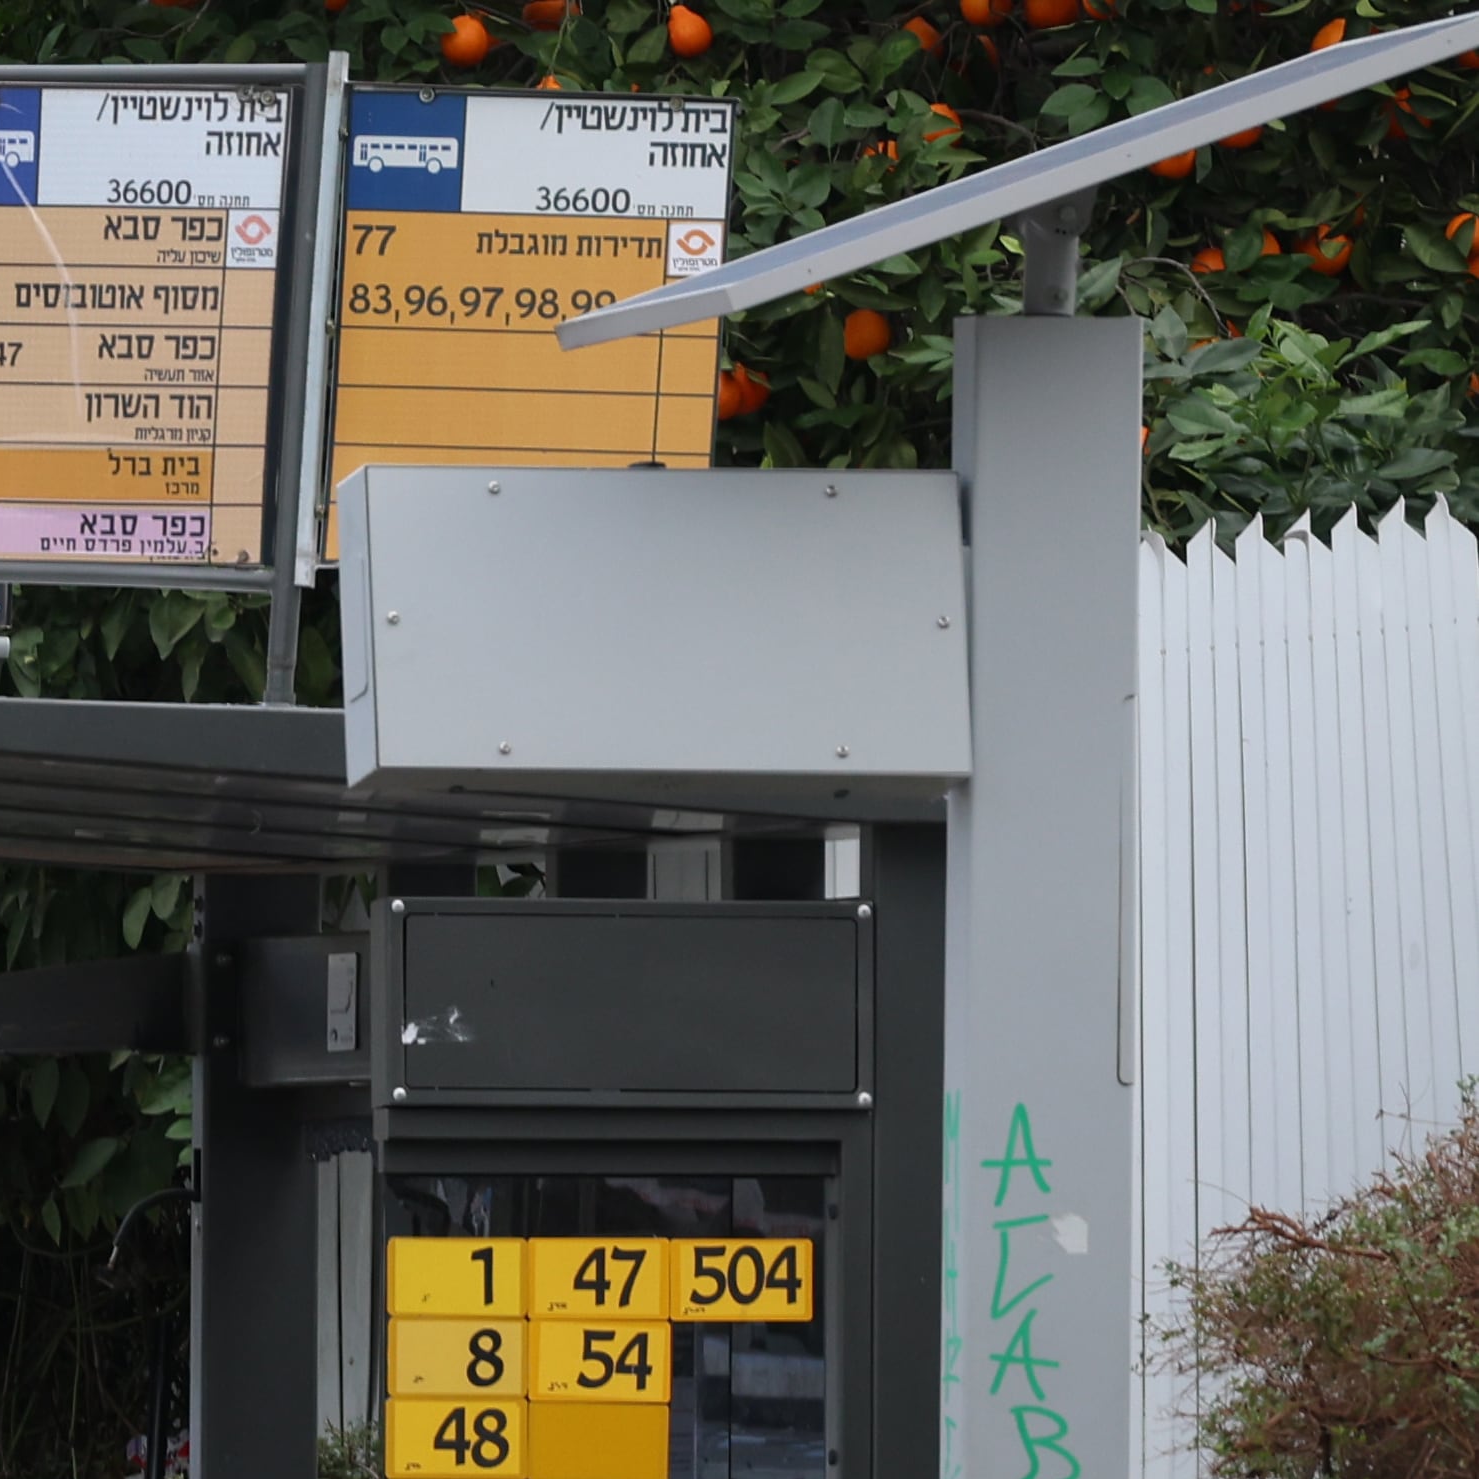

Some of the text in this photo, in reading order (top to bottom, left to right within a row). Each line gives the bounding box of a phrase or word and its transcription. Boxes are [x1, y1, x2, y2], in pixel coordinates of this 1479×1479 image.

[680, 108, 728, 134] בית
[206, 131, 281, 156] אחוזה
[649, 141, 727, 169] אחוזה
[107, 178, 192, 205] 36600
[219, 195, 250, 208] תחנה
[536, 186, 631, 214] 36600
[661, 204, 694, 218] תחנה
[104, 215, 223, 242] כפר סבא
[352, 224, 397, 257] 77
[157, 250, 186, 263] עליה
[190, 251, 221, 265] שיכון
[476, 229, 662, 260] תדירות מוגבלת
[672, 255, 718, 268] מטרופולין
[15, 283, 219, 314] מסוף אוטובוסים
[99, 333, 216, 360] כפר סבא
[144, 368, 215, 382] אזור תעשיה
[85, 393, 212, 422] הוד השרון
[135, 427, 211, 443] קניון מרגליות
[108, 453, 200, 476] בית ברל
[165, 482, 200, 495] מרכז
[80, 513, 205, 537] כפר סבא
[41, 537, 76, 552] חיים
[85, 538, 132, 552] פרדס
[471, 1246, 495, 1307] 1
[573, 1245, 647, 1308] 47
[689, 1245, 802, 1306] 504
[466, 1328, 504, 1387] 8
[576, 1329, 652, 1390] 54
[433, 1407, 509, 1468] 48
